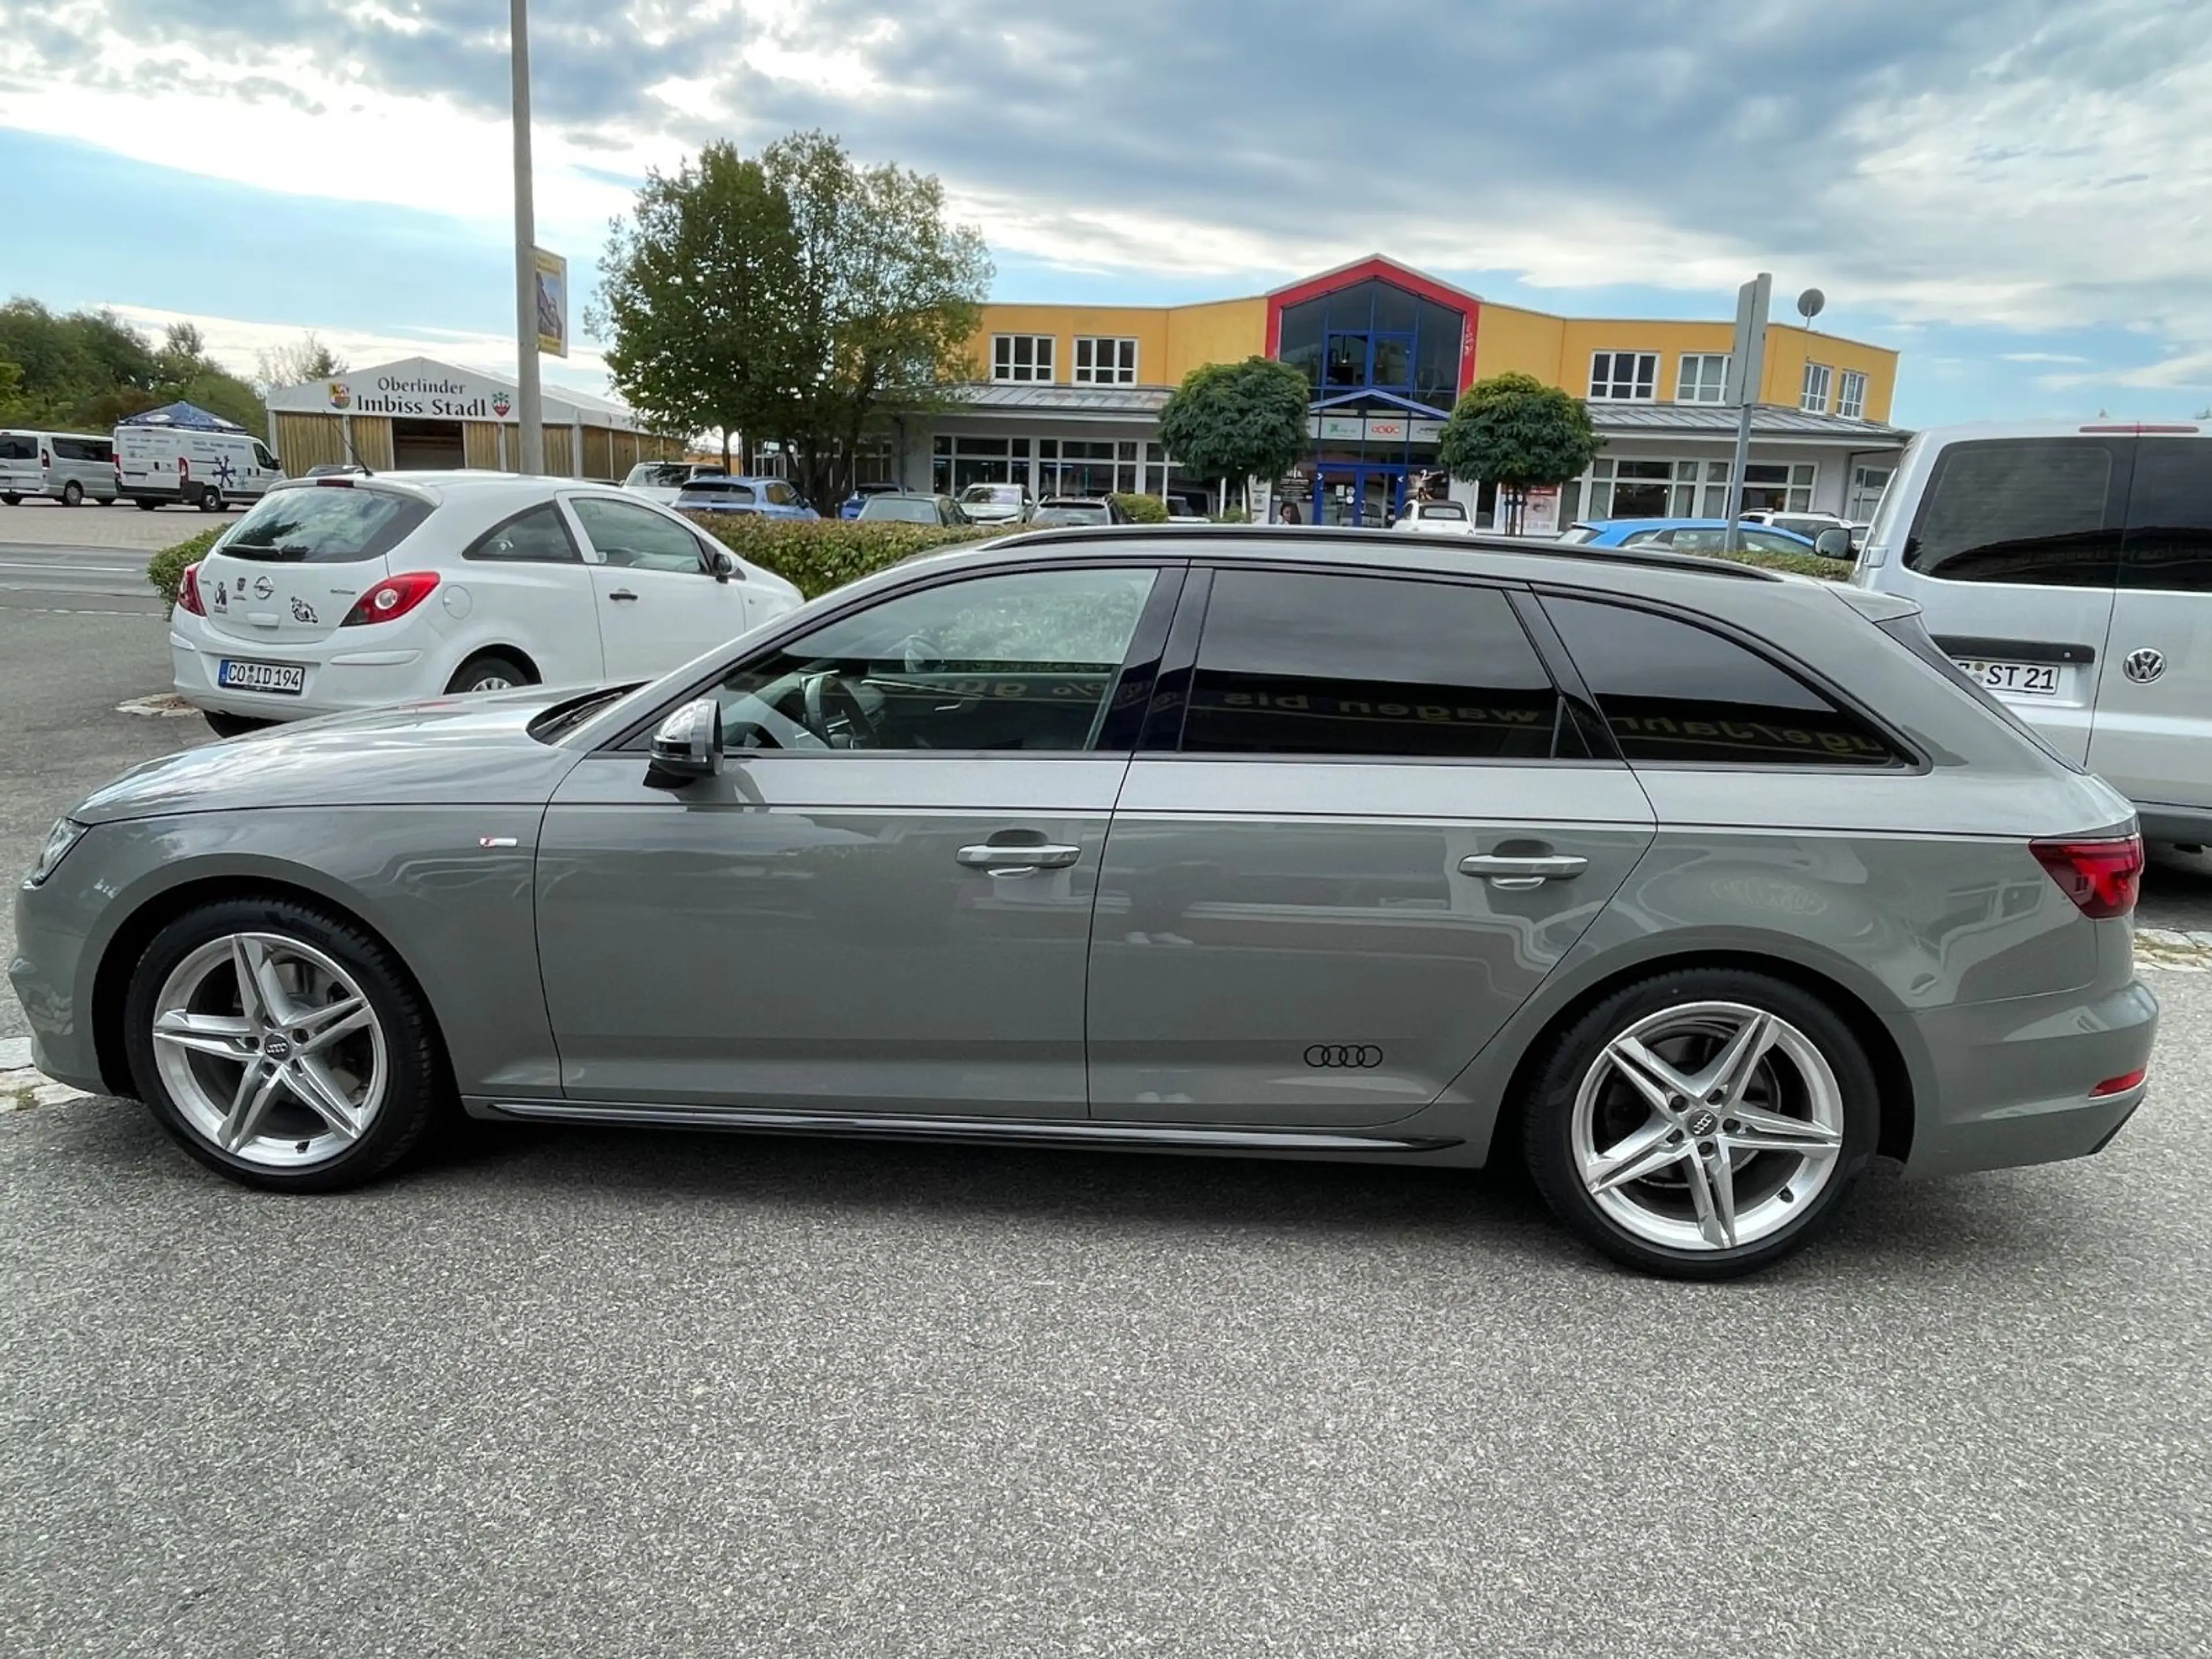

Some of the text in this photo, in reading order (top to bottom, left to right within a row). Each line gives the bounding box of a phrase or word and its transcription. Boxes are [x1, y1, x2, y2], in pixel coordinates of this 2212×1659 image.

[378, 376, 465, 394] Oberlinder
[357, 395, 487, 417] Imbiss Stadl
[229, 664, 300, 687] CO ID 194
[1986, 665, 2020, 686] ST
[2024, 667, 2054, 690] 21
